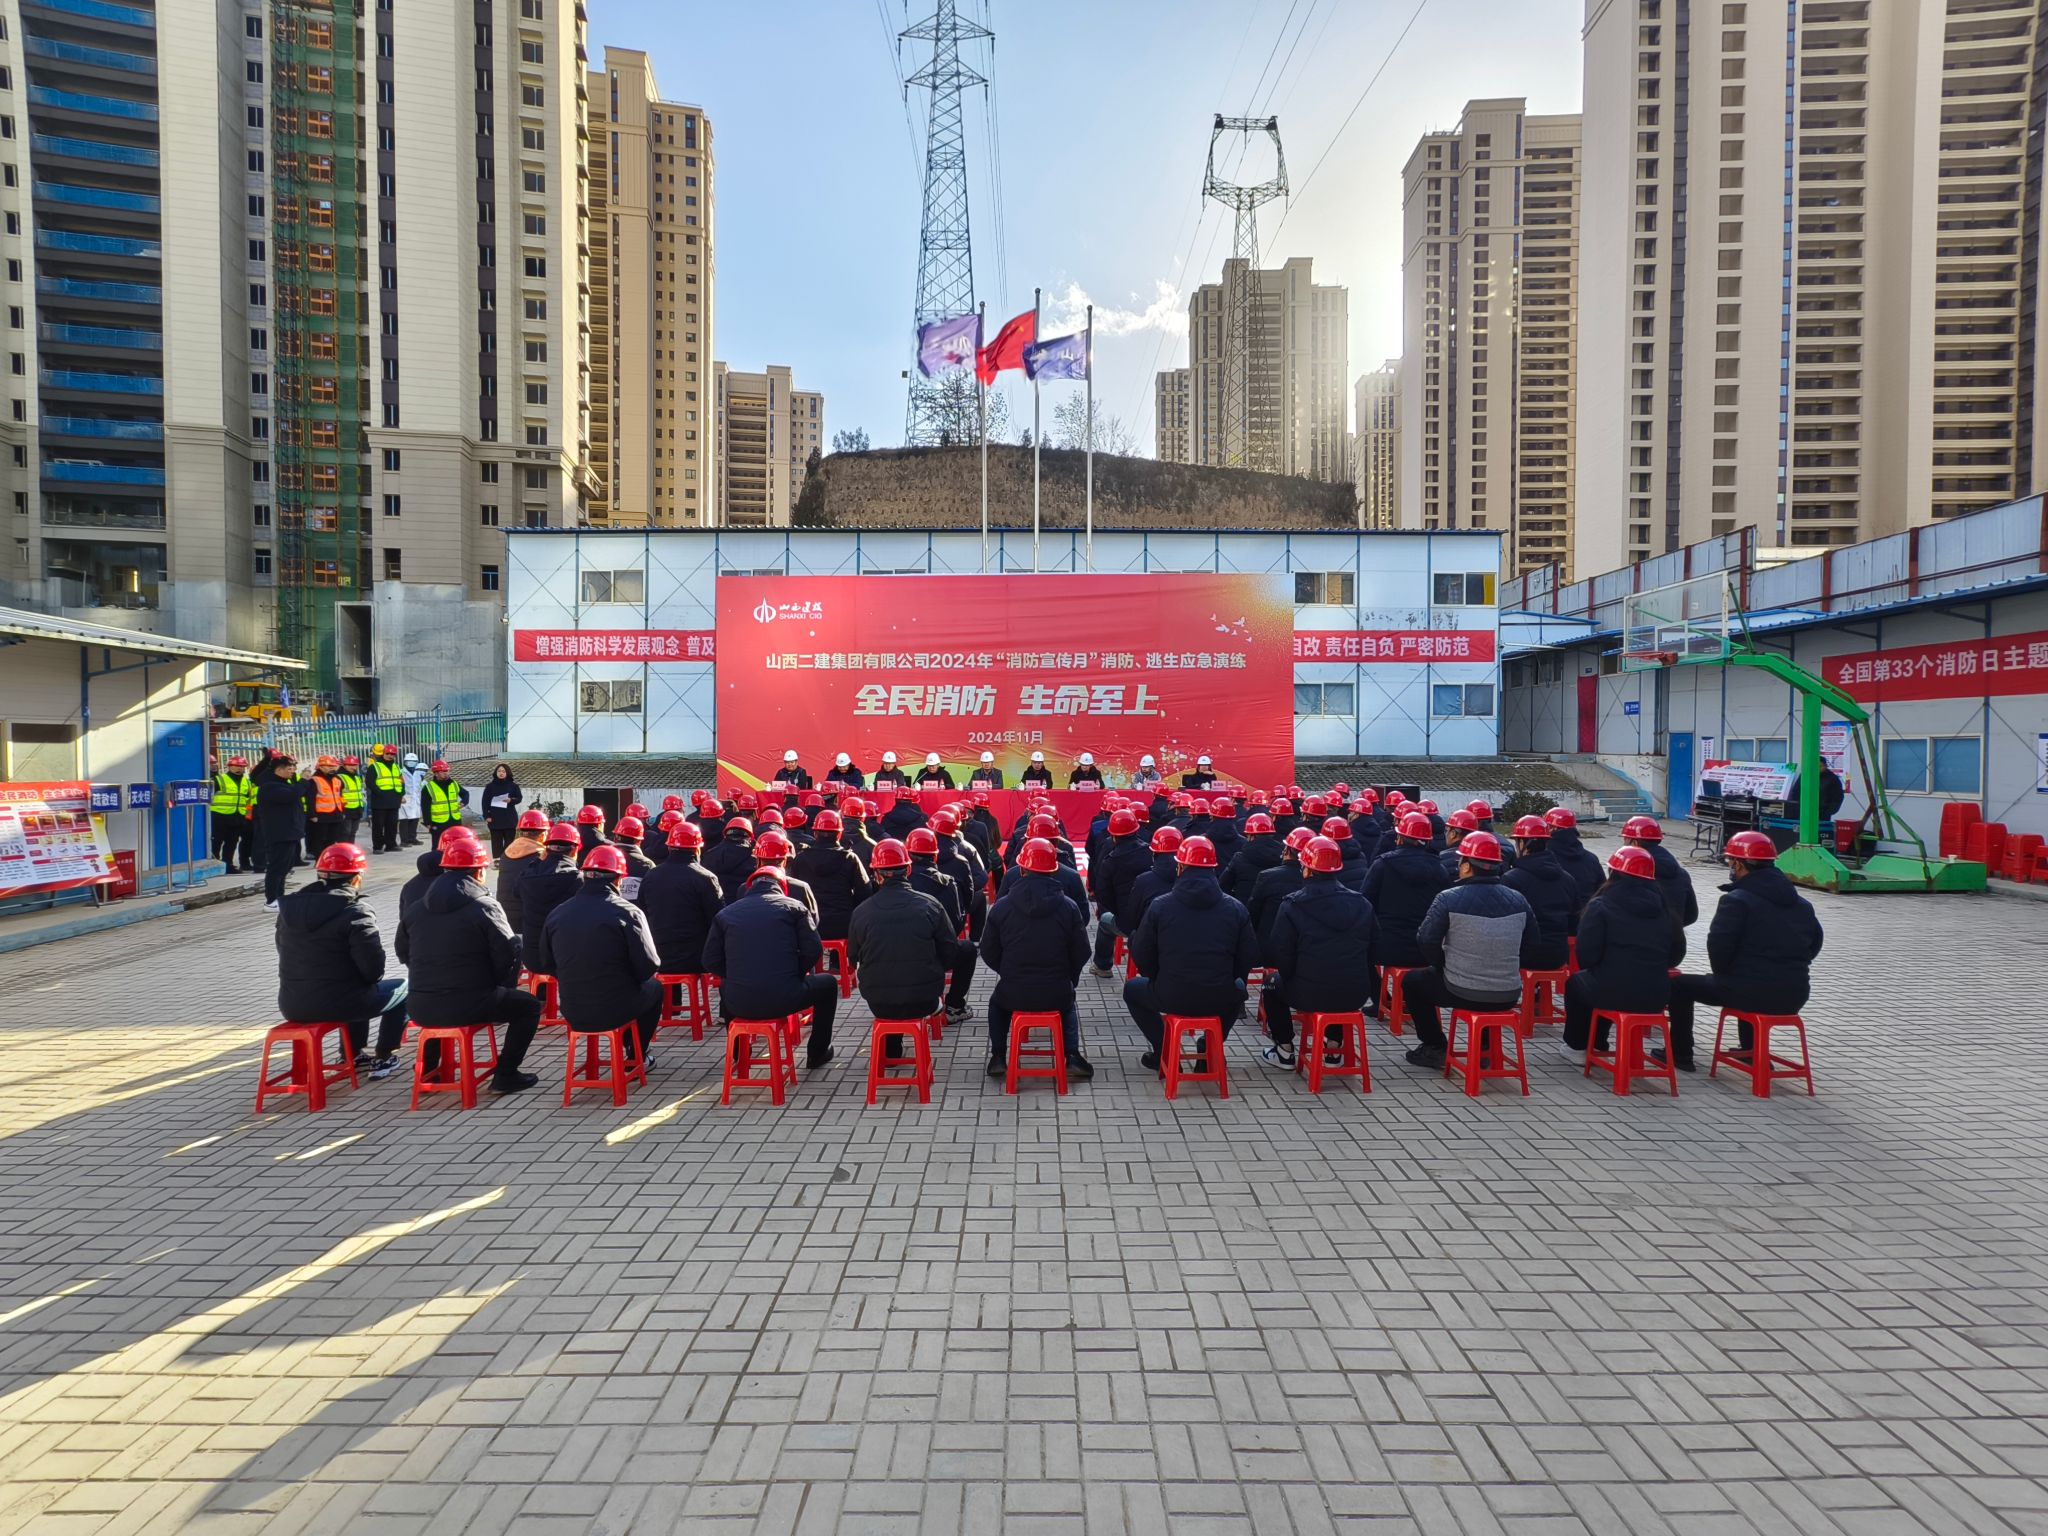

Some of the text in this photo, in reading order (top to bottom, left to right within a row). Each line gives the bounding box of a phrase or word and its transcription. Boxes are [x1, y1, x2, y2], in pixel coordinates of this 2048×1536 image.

[535, 635, 715, 656] 增强消防科学发展观念 普及
[1293, 637, 1470, 657] 自改 责任自负 严密防范
[1839, 642, 2048, 685] 全国第33个消防日主题
[852, 684, 1160, 716] 全民消防 生命至上
[967, 730, 1044, 745] 2024年11月
